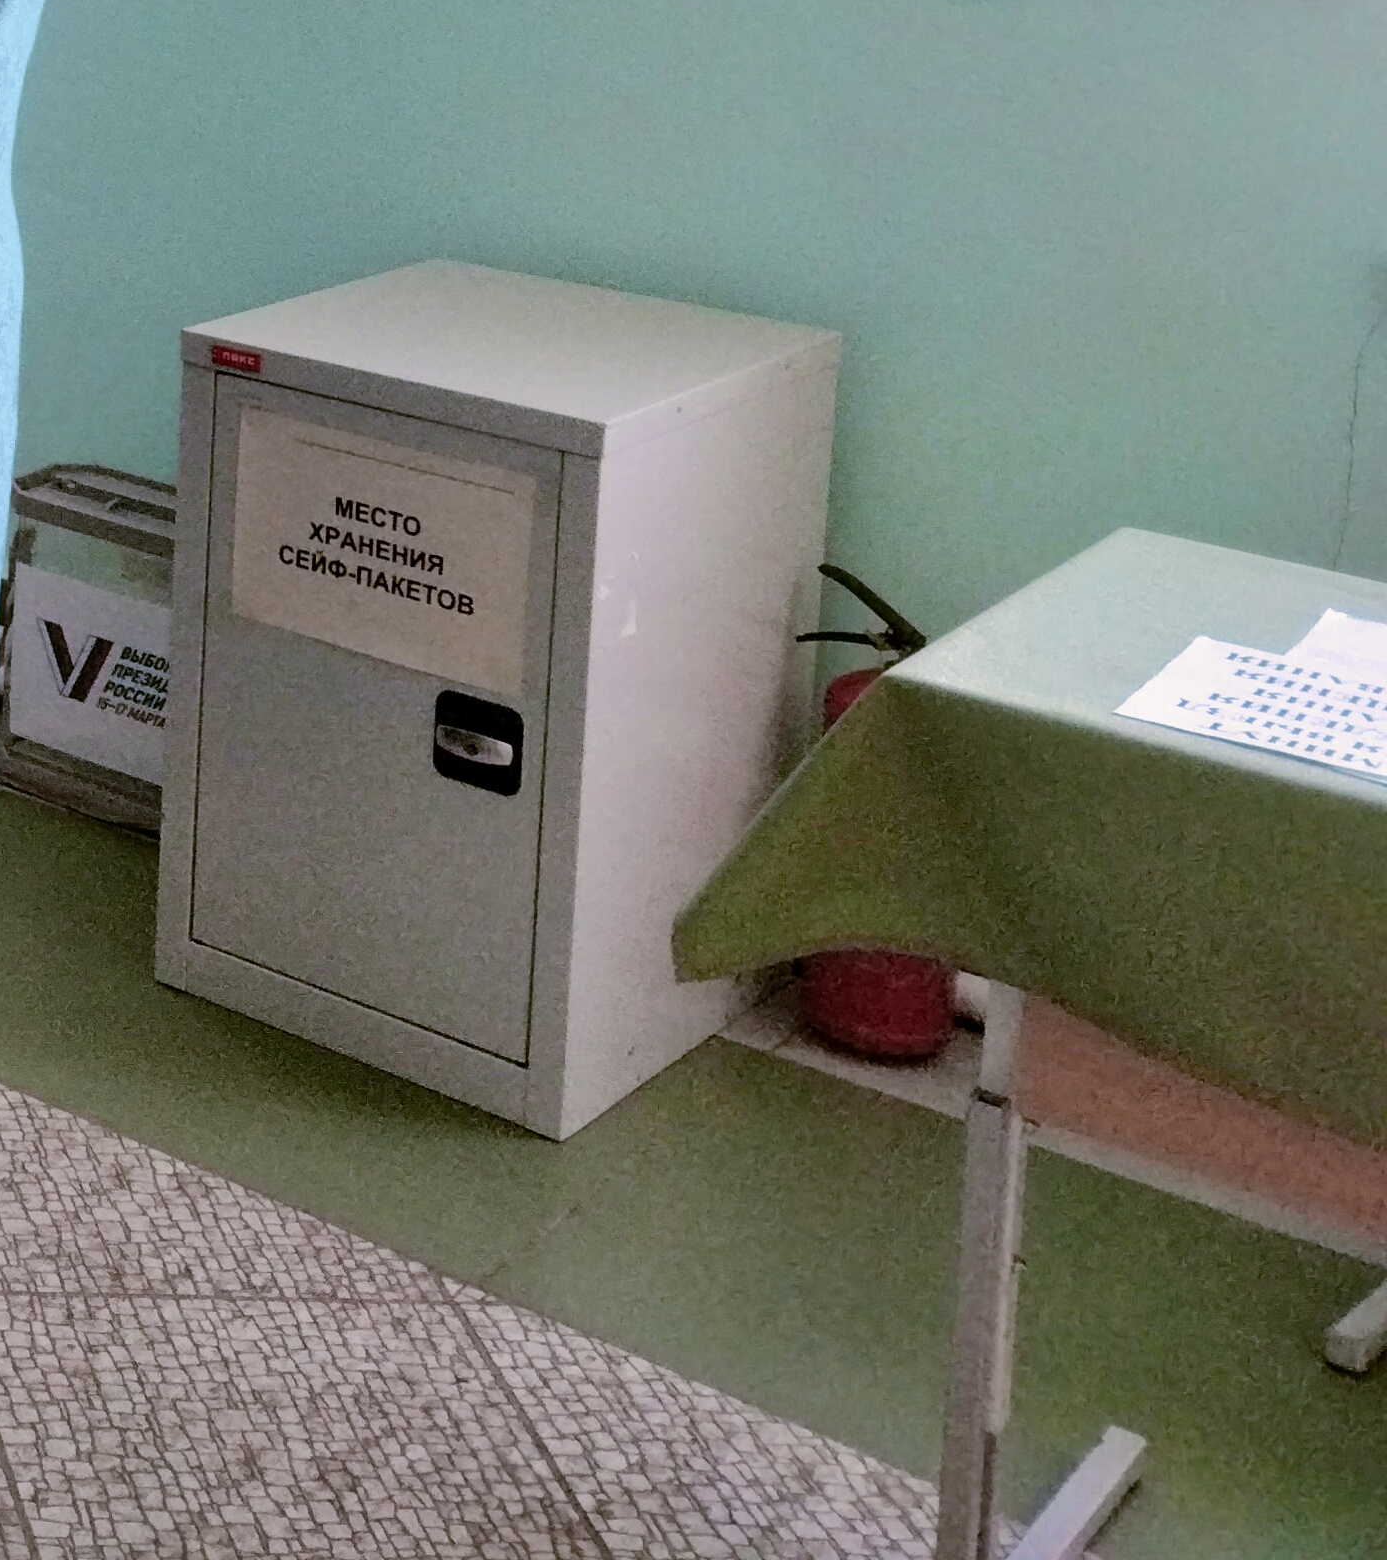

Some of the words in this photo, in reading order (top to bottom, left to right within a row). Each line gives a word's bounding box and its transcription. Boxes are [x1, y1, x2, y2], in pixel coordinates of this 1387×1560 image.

[335, 496, 422, 537] МЕСТО
[308, 521, 445, 576] ХРАНЕНИЯ
[279, 544, 475, 616] СЕЙФ-ПАКЕТОВ
[103, 679, 168, 712] РОССИИ
[126, 706, 167, 729] МАРТА
